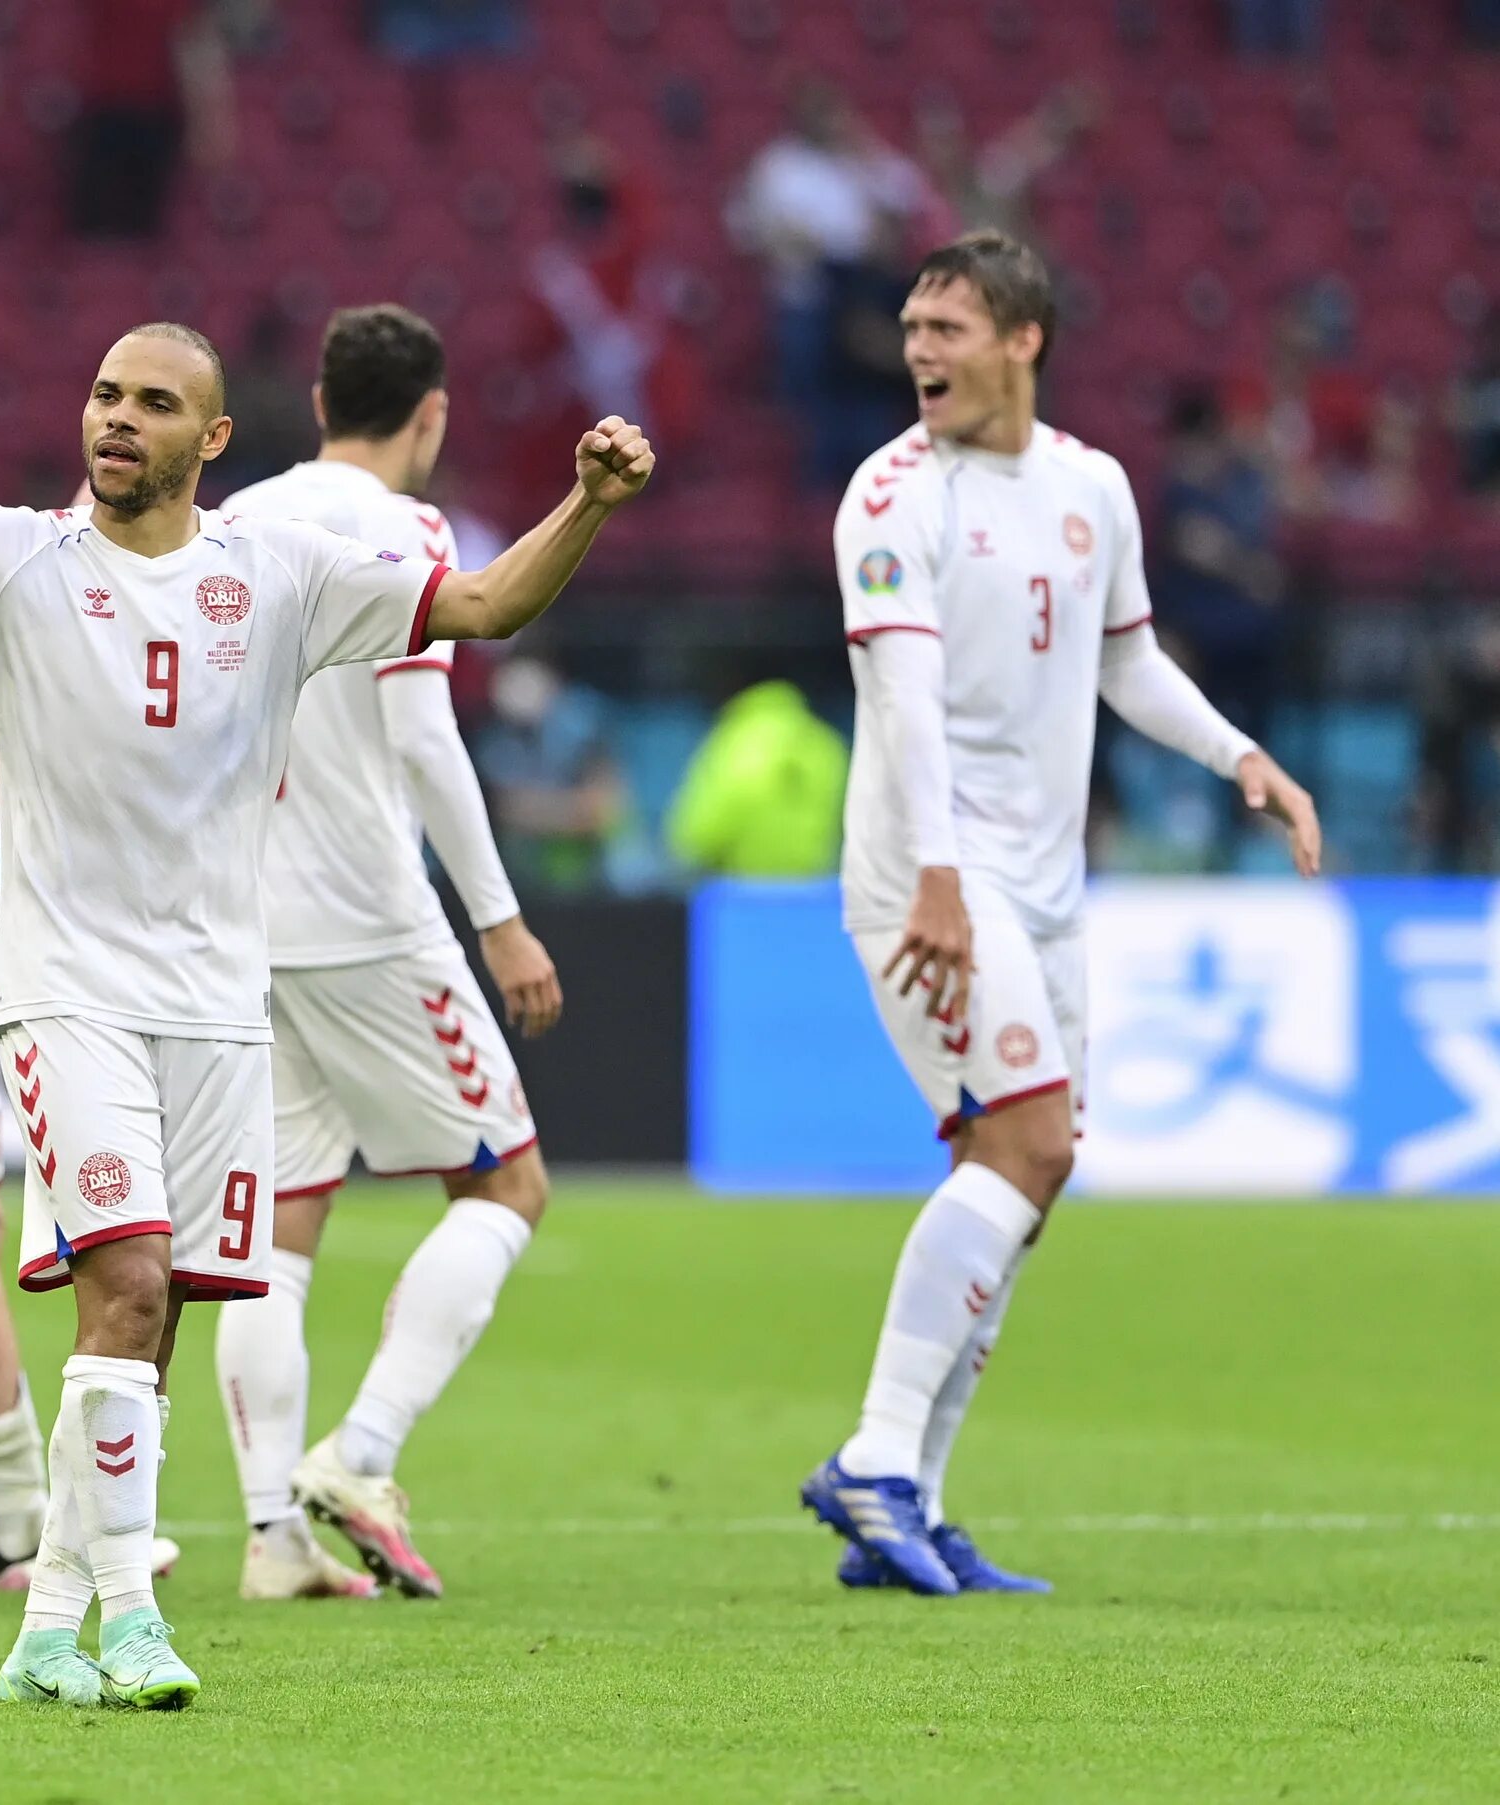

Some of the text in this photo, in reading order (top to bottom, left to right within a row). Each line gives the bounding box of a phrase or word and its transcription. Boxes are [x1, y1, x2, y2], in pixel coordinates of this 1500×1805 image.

[206, 590, 241, 606] DBU
[1029, 576, 1051, 654] 3
[145, 641, 179, 728] 9
[88, 1168, 123, 1190] DBU
[219, 1171, 257, 1260] 9
